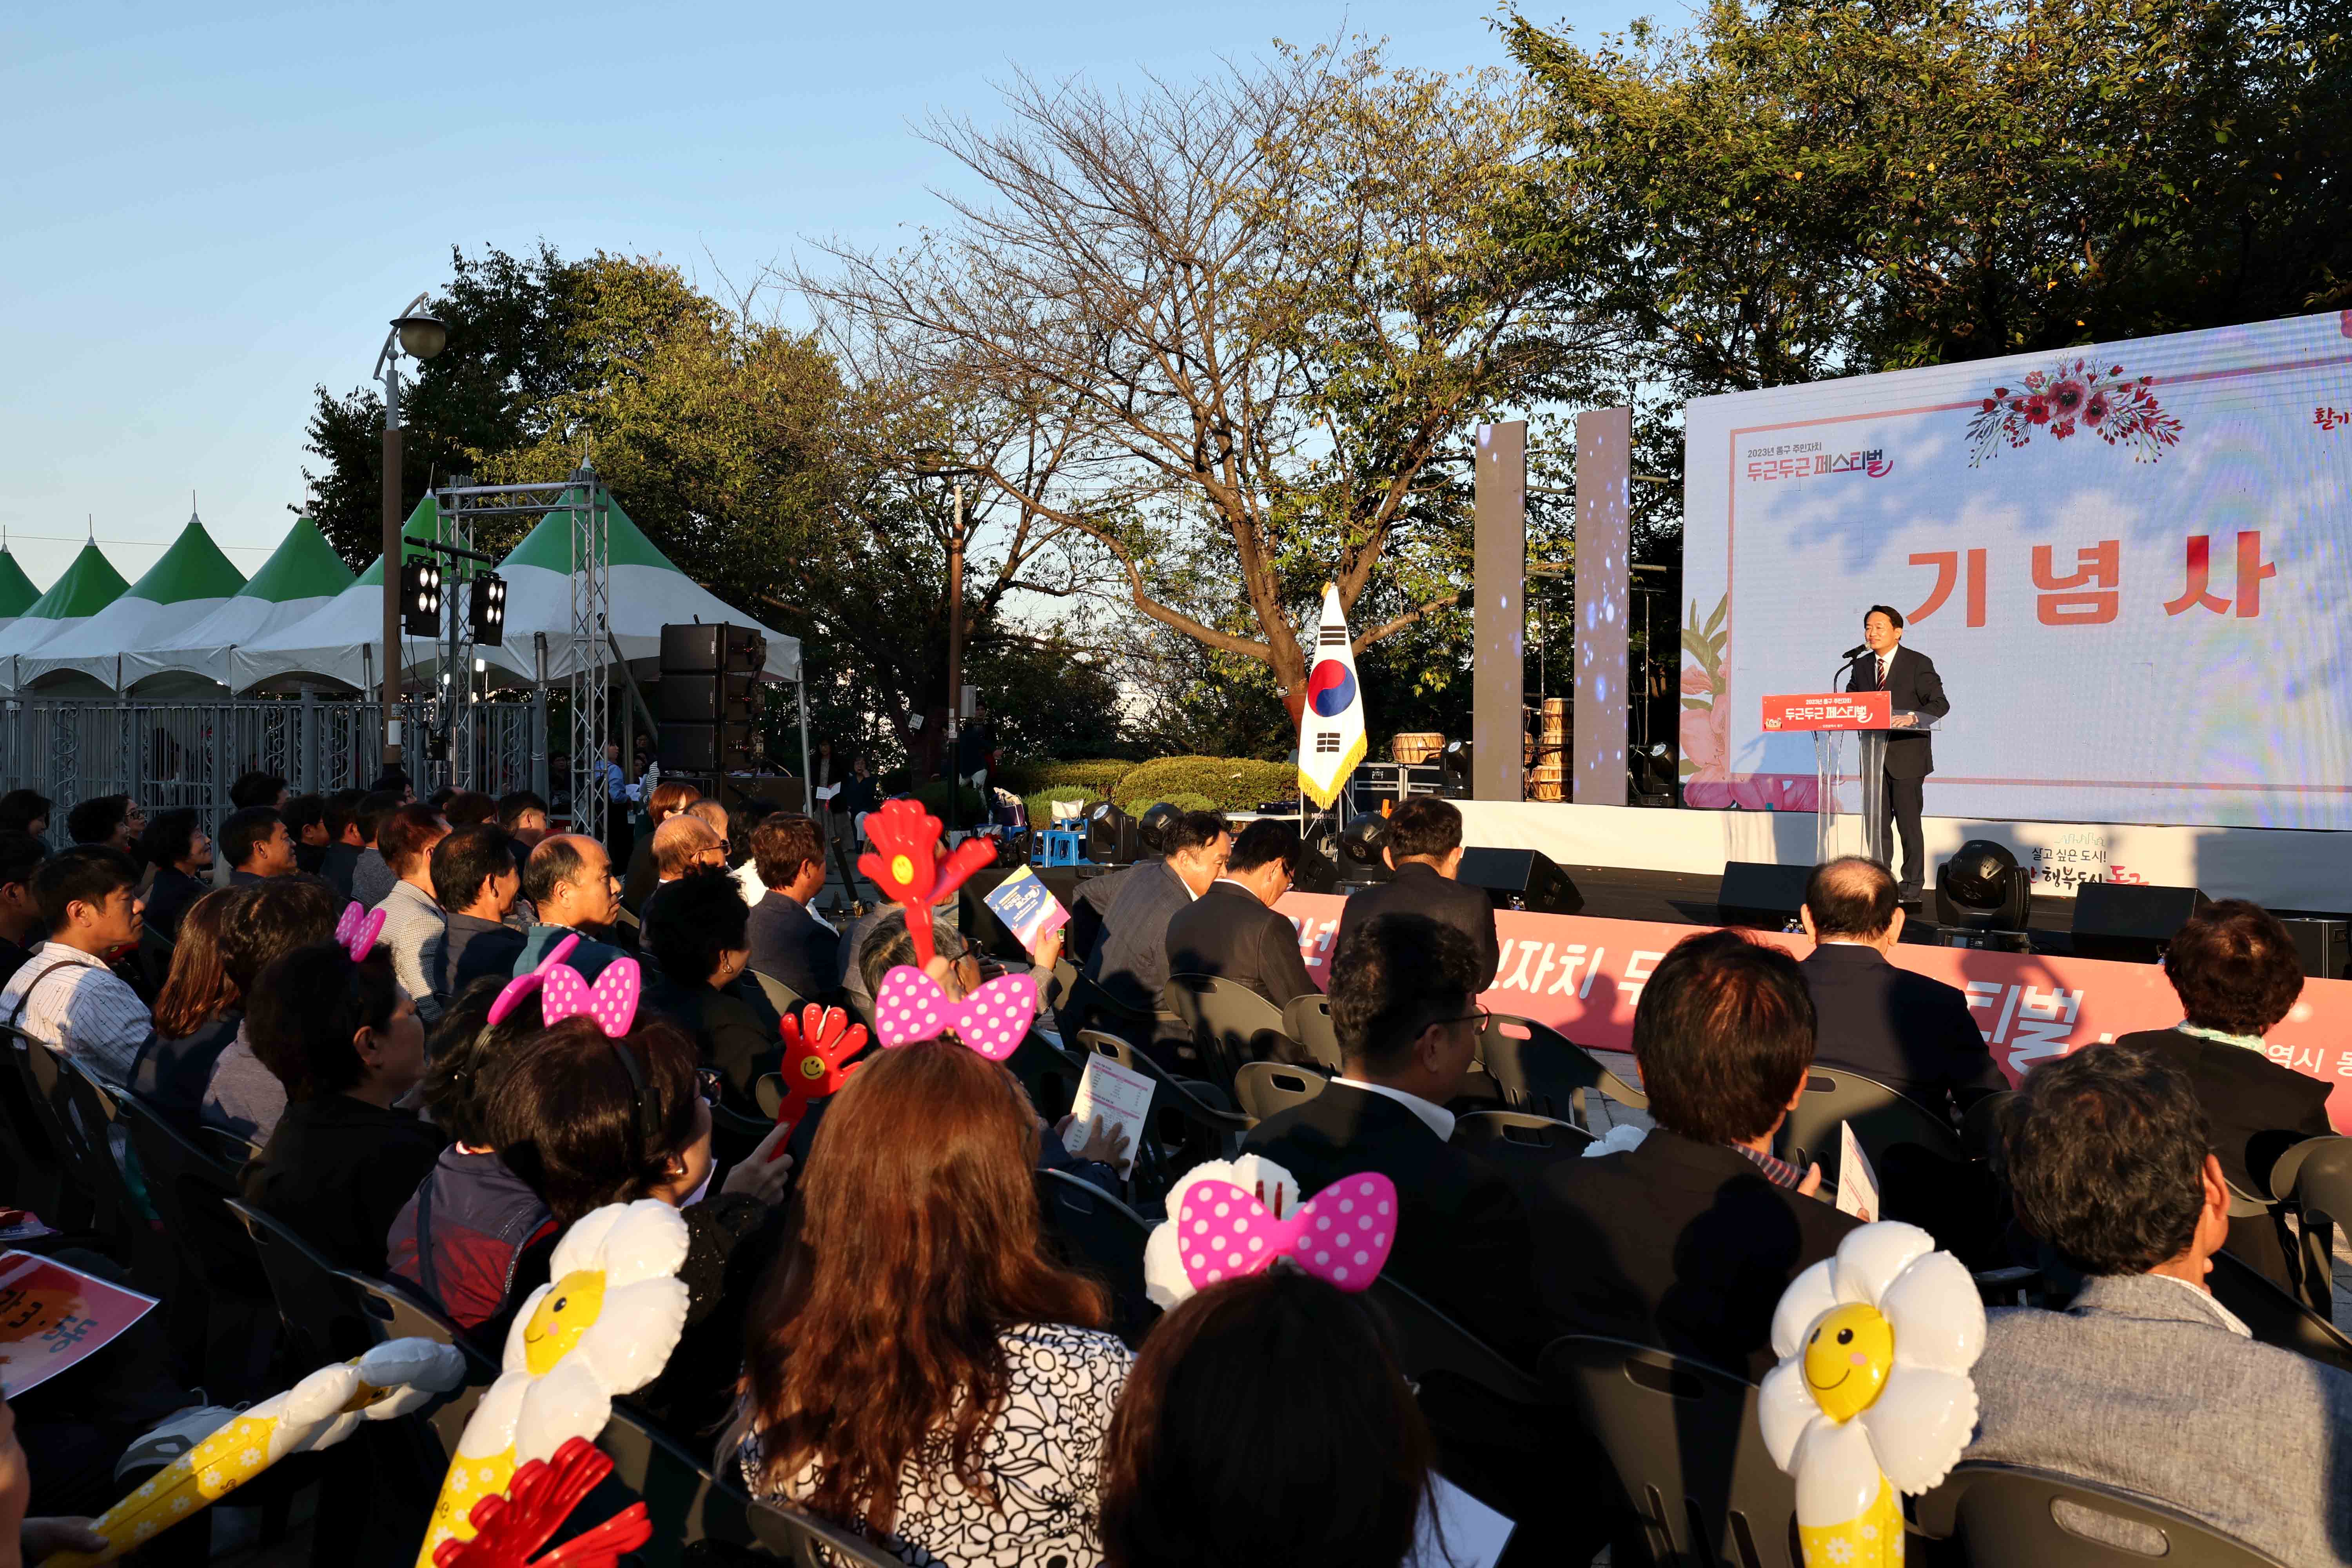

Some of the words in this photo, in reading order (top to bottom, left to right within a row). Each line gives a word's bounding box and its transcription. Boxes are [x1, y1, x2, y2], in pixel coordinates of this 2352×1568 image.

[2313, 407, 2352, 430] 활기
[1748, 447, 1774, 458] 2023년
[1776, 445, 1791, 456] 동구
[1793, 442, 1822, 454] 주민자치
[1748, 457, 1810, 481] 두근두근
[1813, 449, 1893, 478] 페스티벌
[1785, 706, 1824, 720] 두근두근
[1826, 705, 1873, 723] 페스티벌
[2032, 848, 2053, 861] 살고
[2056, 849, 2078, 862] 싶은
[2080, 850, 2107, 863] 도시!
[2265, 1044, 2325, 1073] 역시
